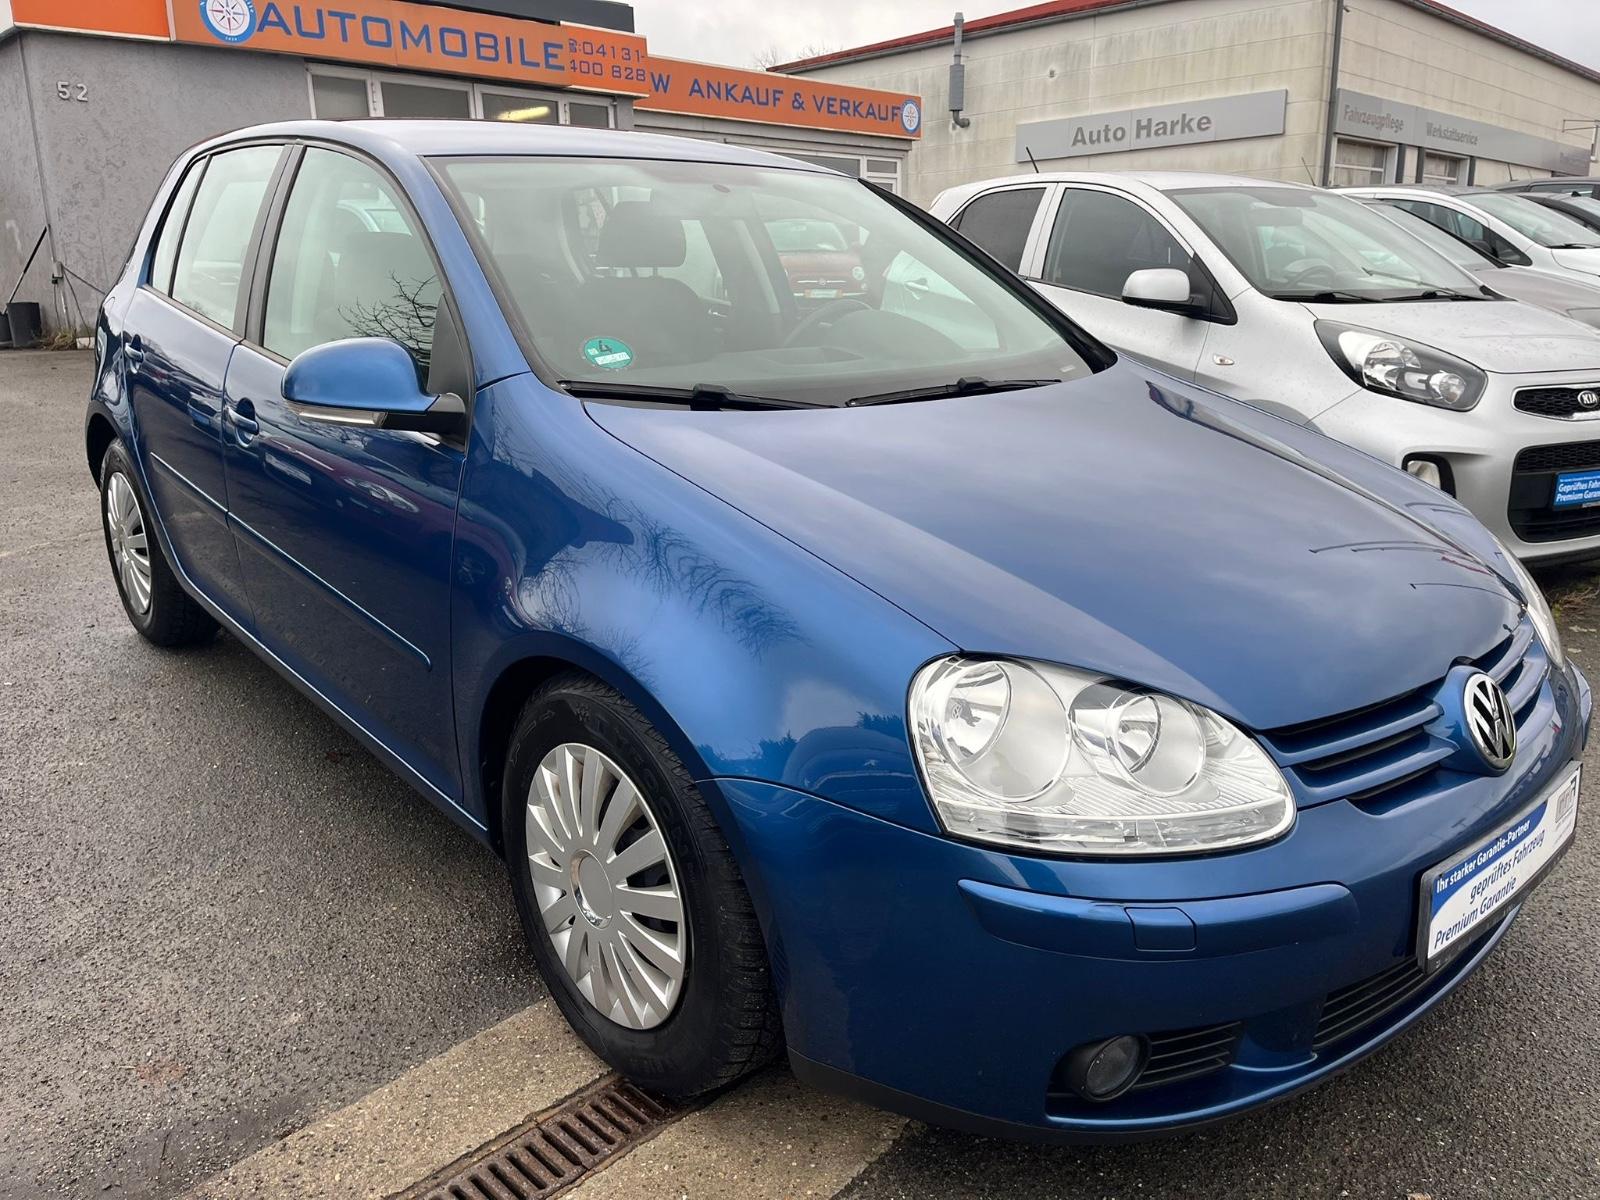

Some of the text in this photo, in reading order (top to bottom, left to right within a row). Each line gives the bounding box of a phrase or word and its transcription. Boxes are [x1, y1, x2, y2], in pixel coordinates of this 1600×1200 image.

[257, 2, 565, 71] AUTOMOBILE
[57, 81, 88, 102] 52
[612, 65, 645, 81] 828
[689, 78, 784, 107] ANKAUF
[792, 92, 805, 111] &
[812, 95, 901, 122] VERKAUF
[1343, 104, 1404, 133] Fahrzeugpflege
[1071, 113, 1212, 147] Auto Harke
[1582, 393, 1597, 404] KIA
[1437, 877, 1449, 893] Ihr
[1449, 859, 1477, 885] starker
[1477, 820, 1530, 866] Garantie-Partner
[1470, 829, 1545, 904] geprüftes Fahrzeug
[1434, 876, 1517, 949] Premium Garantie
